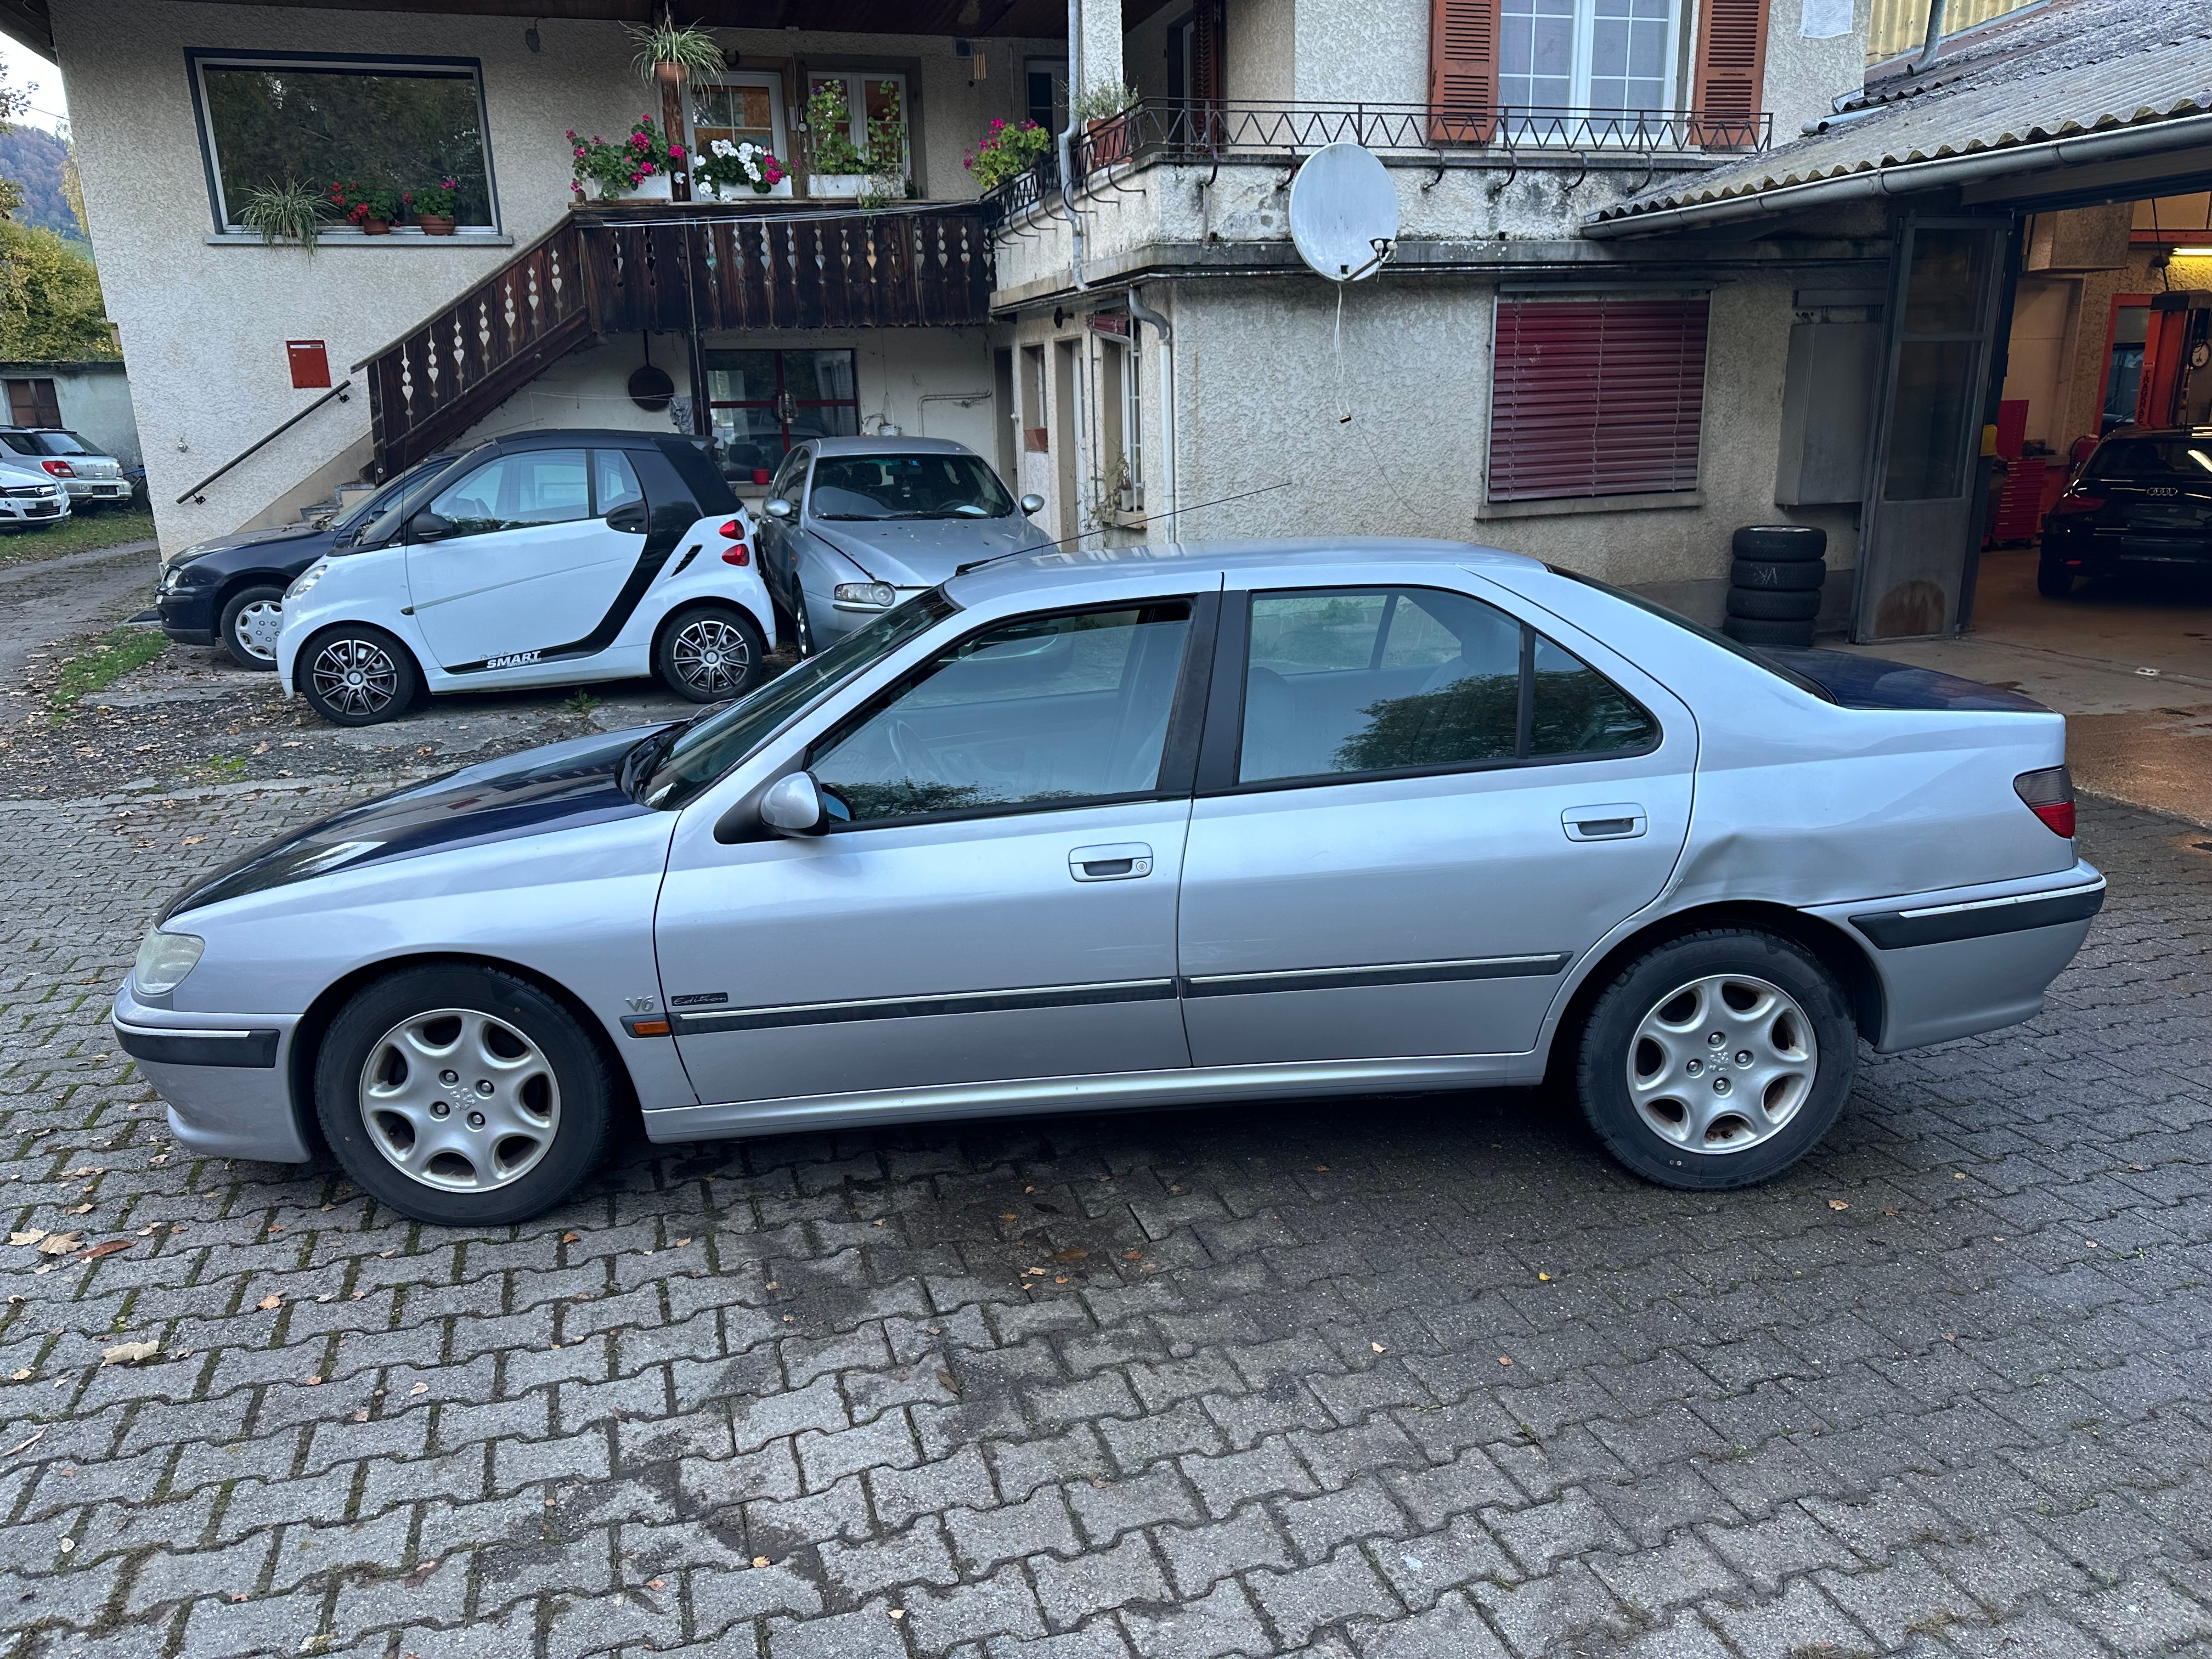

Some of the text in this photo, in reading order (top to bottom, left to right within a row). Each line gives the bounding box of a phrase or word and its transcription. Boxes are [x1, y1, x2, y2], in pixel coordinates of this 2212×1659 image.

[487, 651, 541, 668] SMART
[624, 996, 654, 1012] V6
[674, 994, 727, 1005] Edition
